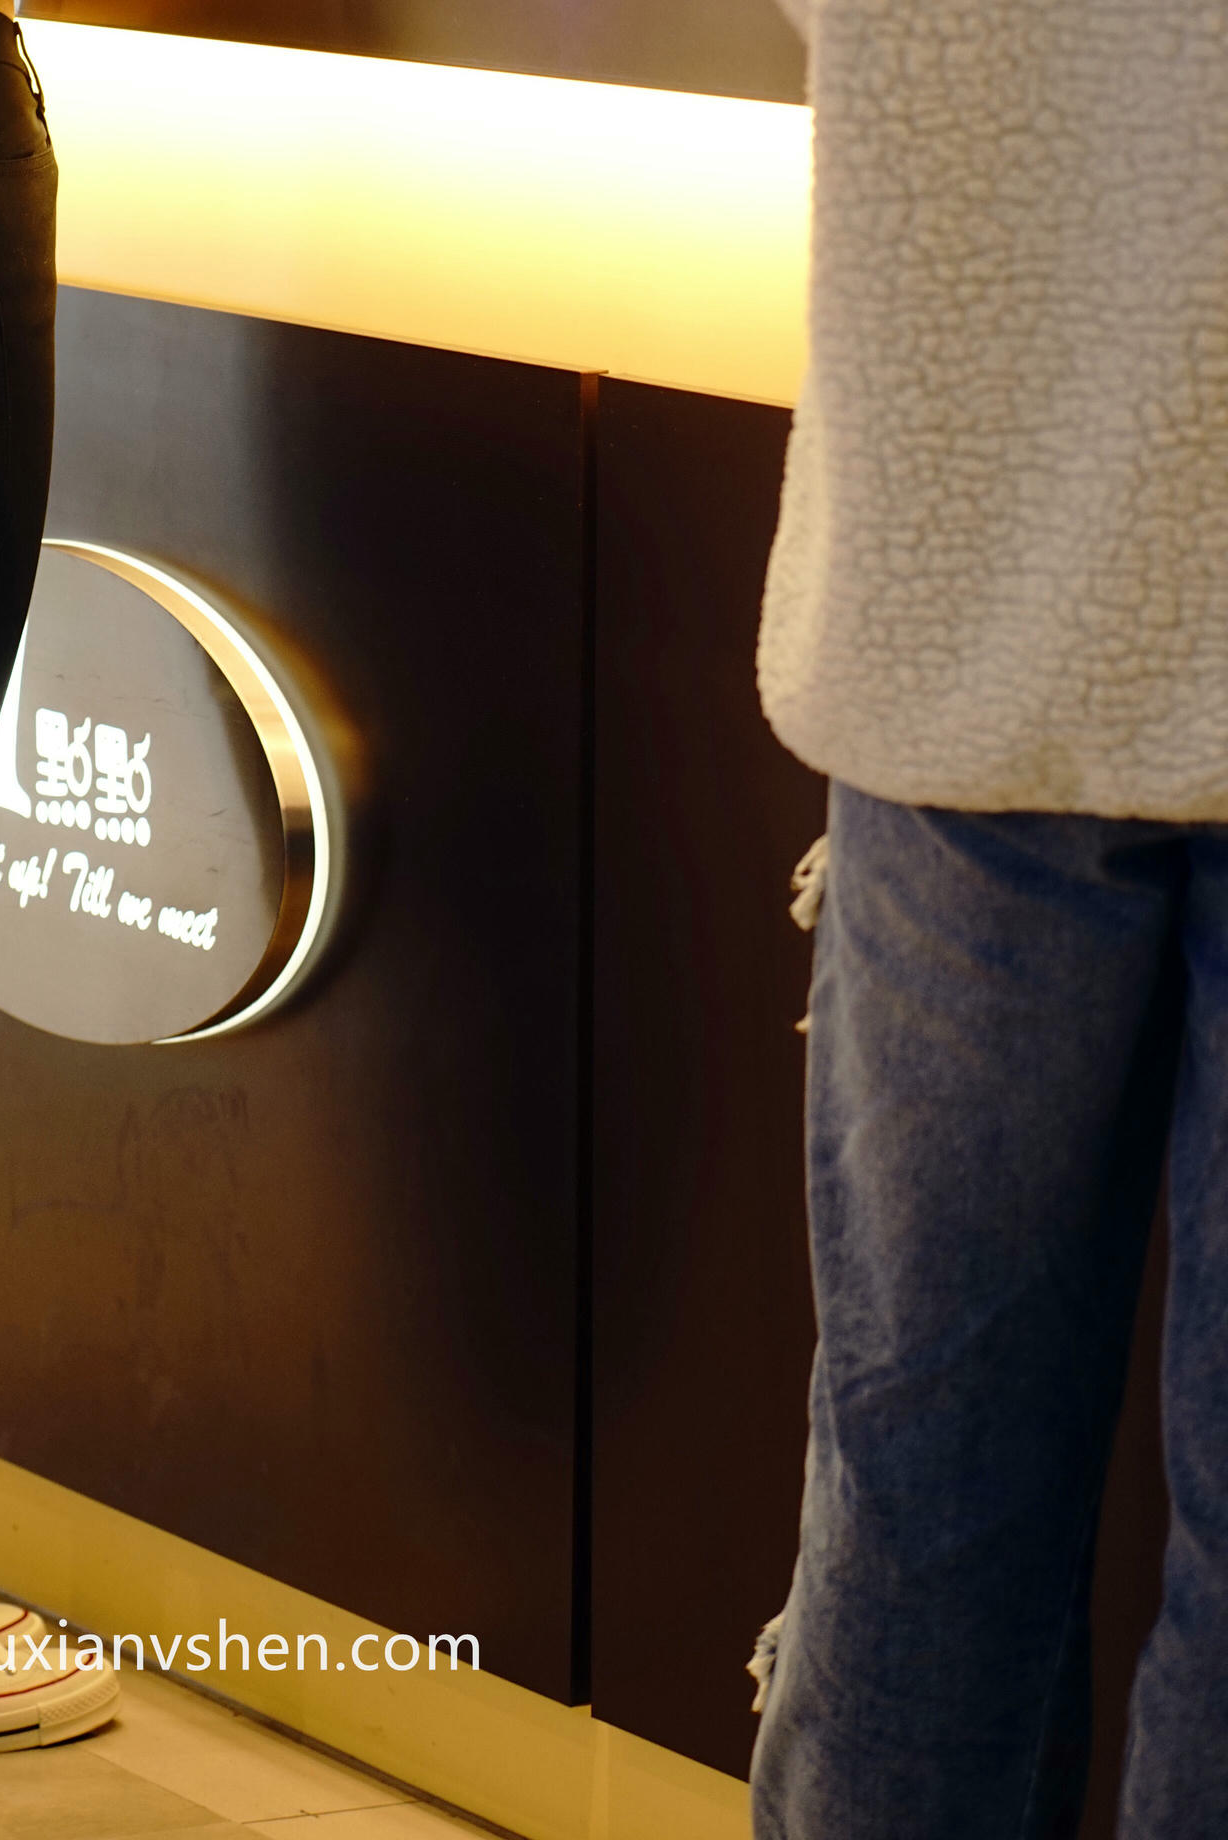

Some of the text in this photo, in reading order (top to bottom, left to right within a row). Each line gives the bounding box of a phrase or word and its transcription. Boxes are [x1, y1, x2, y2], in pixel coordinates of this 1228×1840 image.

[62, 851, 115, 919] Till
[117, 891, 153, 931] we
[158, 907, 219, 951] meet
